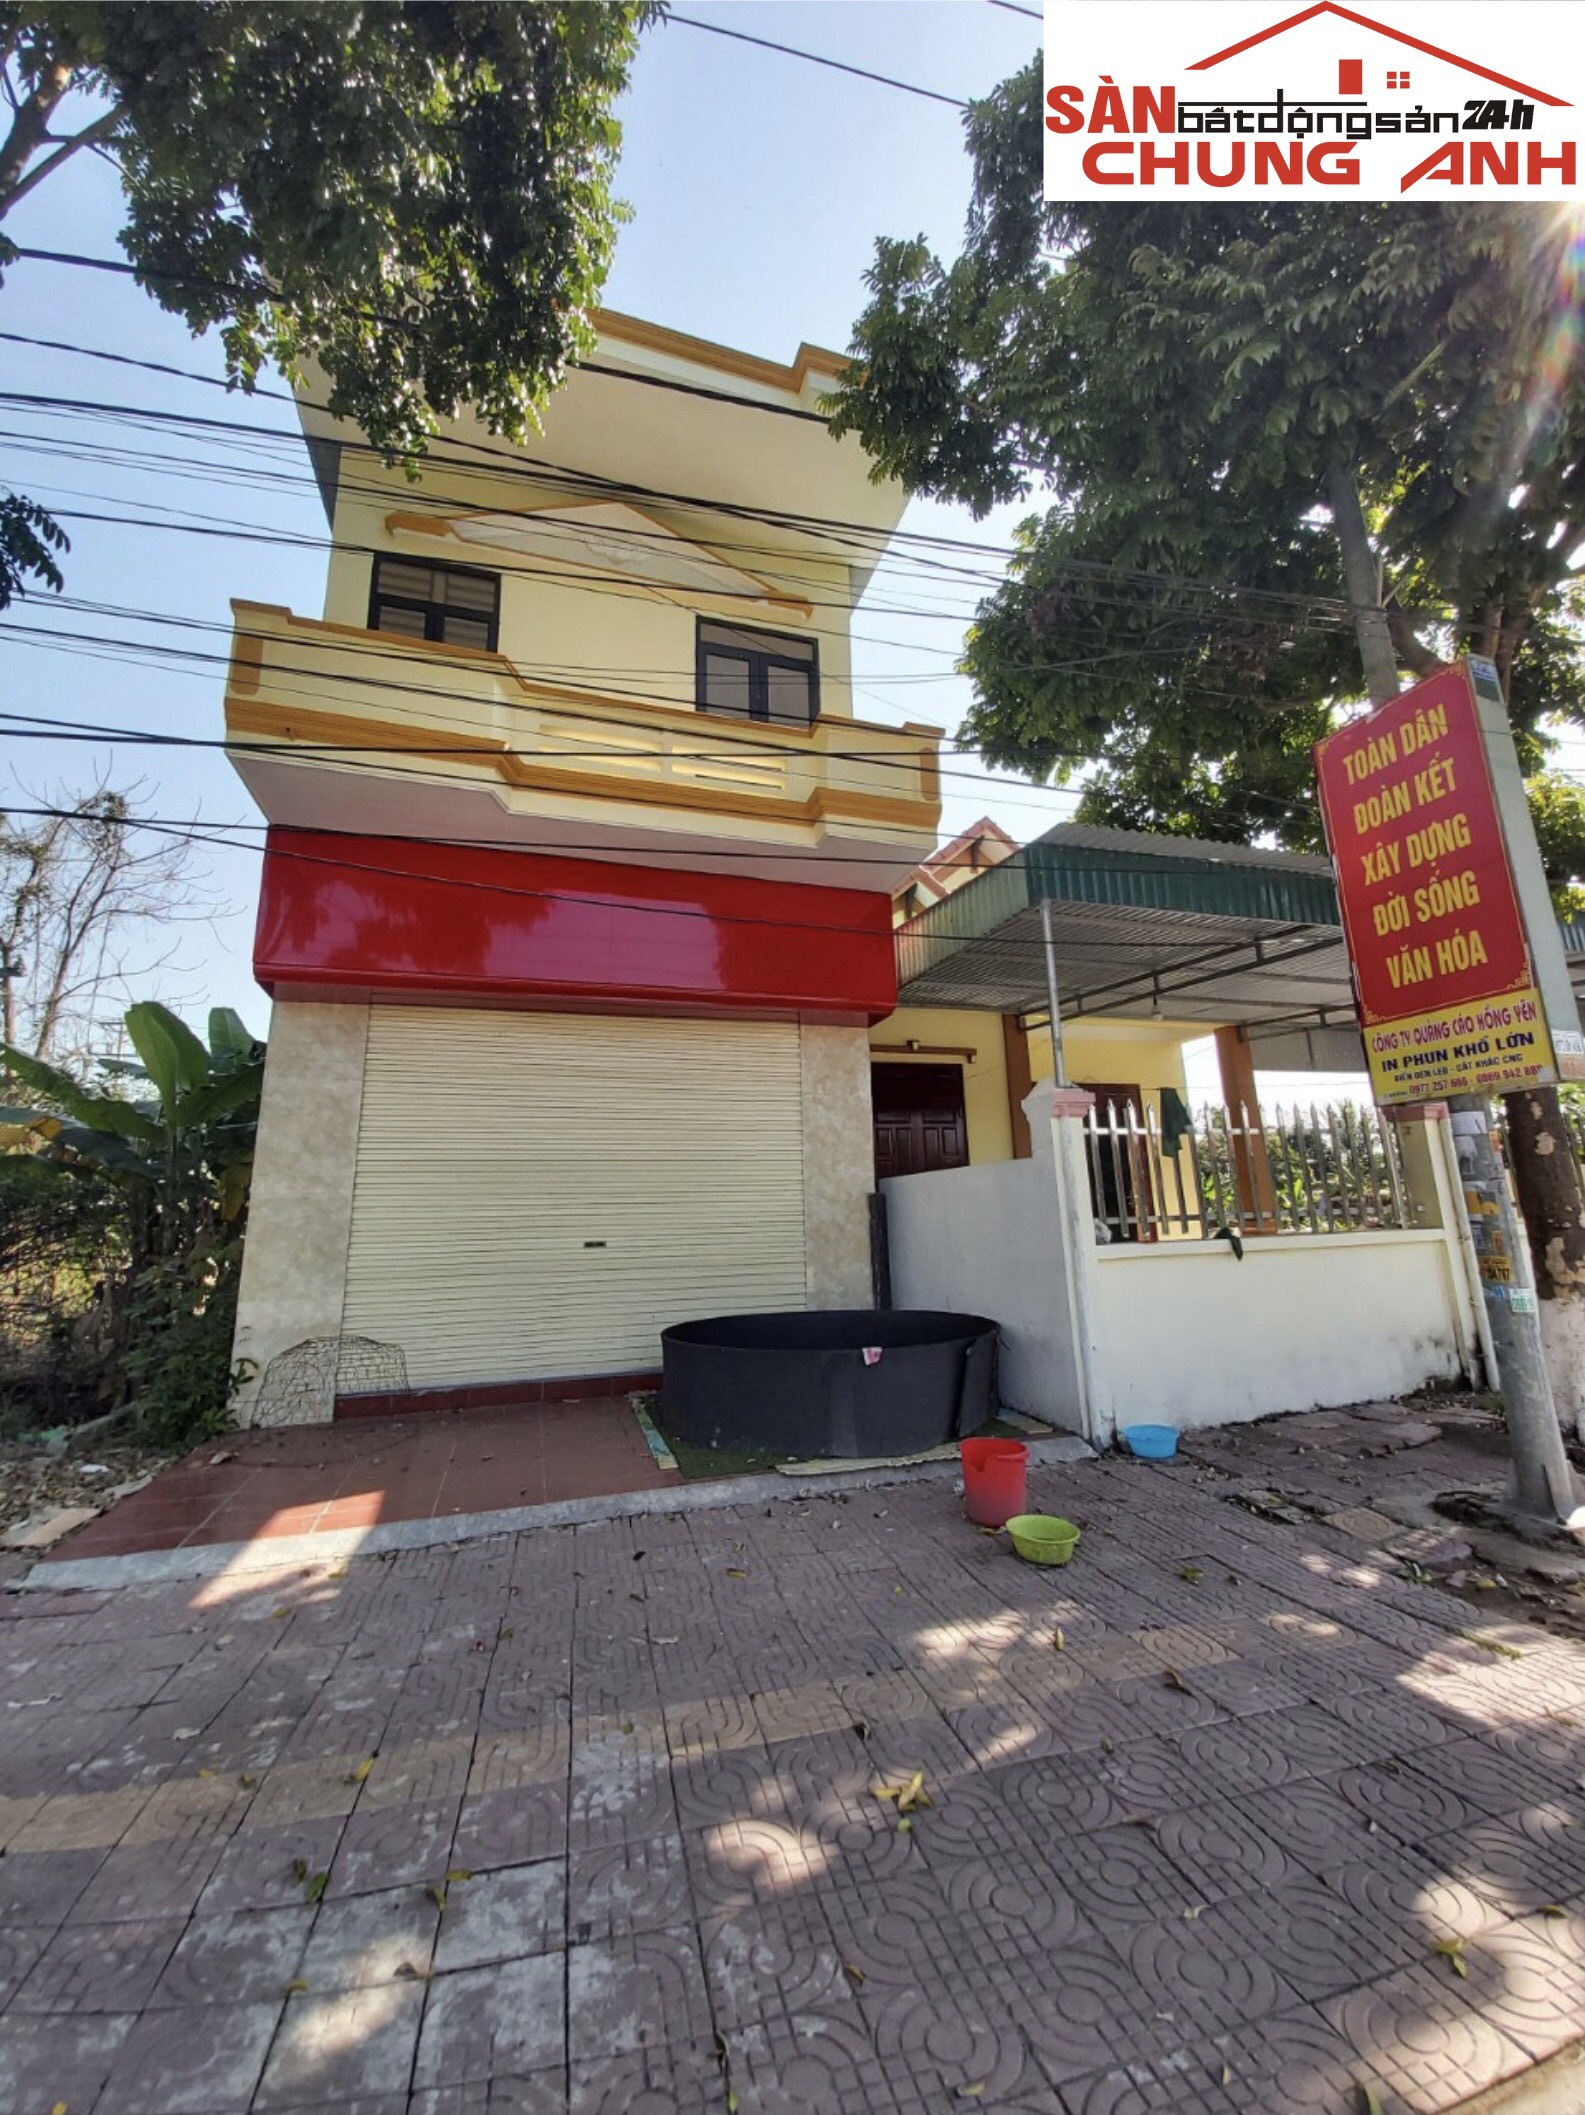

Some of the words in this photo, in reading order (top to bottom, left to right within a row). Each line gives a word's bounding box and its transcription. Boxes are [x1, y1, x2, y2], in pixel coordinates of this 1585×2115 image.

[1342, 733, 1398, 785] TOÀN
[1400, 703, 1449, 757] DÂN
[1353, 784, 1412, 835] ĐOÀN
[1415, 751, 1457, 807] KẾT
[1361, 841, 1401, 886] XÂY
[1406, 813, 1471, 868] DỰNG
[1373, 887, 1411, 937] ĐỜI
[1414, 868, 1480, 923] SỐNG
[1387, 945, 1434, 988] VĂN
[1436, 928, 1488, 976] HÓA
[1372, 1032, 1398, 1053] CÔNG
[1400, 1030, 1411, 1047] TY
[1452, 1012, 1475, 1036] CÁO
[1382, 1059, 1398, 1072] IN
[1403, 1049, 1448, 1068] PHUN
[1453, 1035, 1489, 1059] KHỔ
[1495, 1032, 1534, 1050] LỚN
